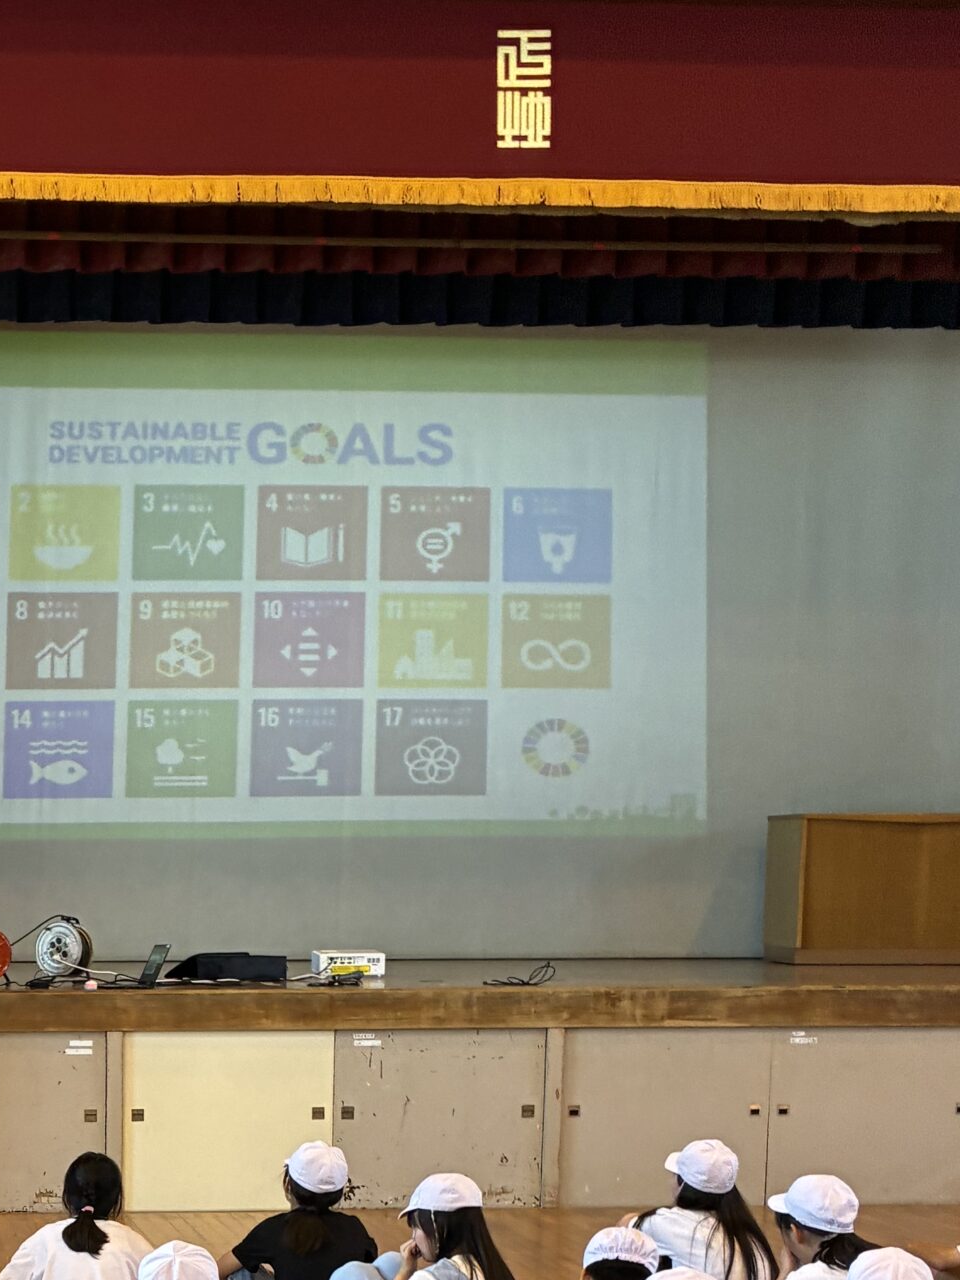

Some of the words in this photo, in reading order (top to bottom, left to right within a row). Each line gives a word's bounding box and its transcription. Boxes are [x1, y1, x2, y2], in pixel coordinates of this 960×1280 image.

[49, 421, 242, 441] SUSTAINABLE
[247, 421, 454, 466] GOALS
[48, 444, 241, 465] DEVELOPMENT
[18, 491, 31, 511] 2
[143, 492, 155, 512] 3
[266, 493, 278, 512] 4
[389, 494, 401, 513] 5
[512, 496, 524, 514] 6
[16, 600, 28, 619] 8
[140, 600, 152, 620] 9
[262, 600, 282, 619] 10
[509, 602, 529, 621] 12
[12, 710, 32, 729] 14
[135, 709, 154, 728] 15
[257, 707, 279, 727] 16
[383, 707, 402, 726] 17
